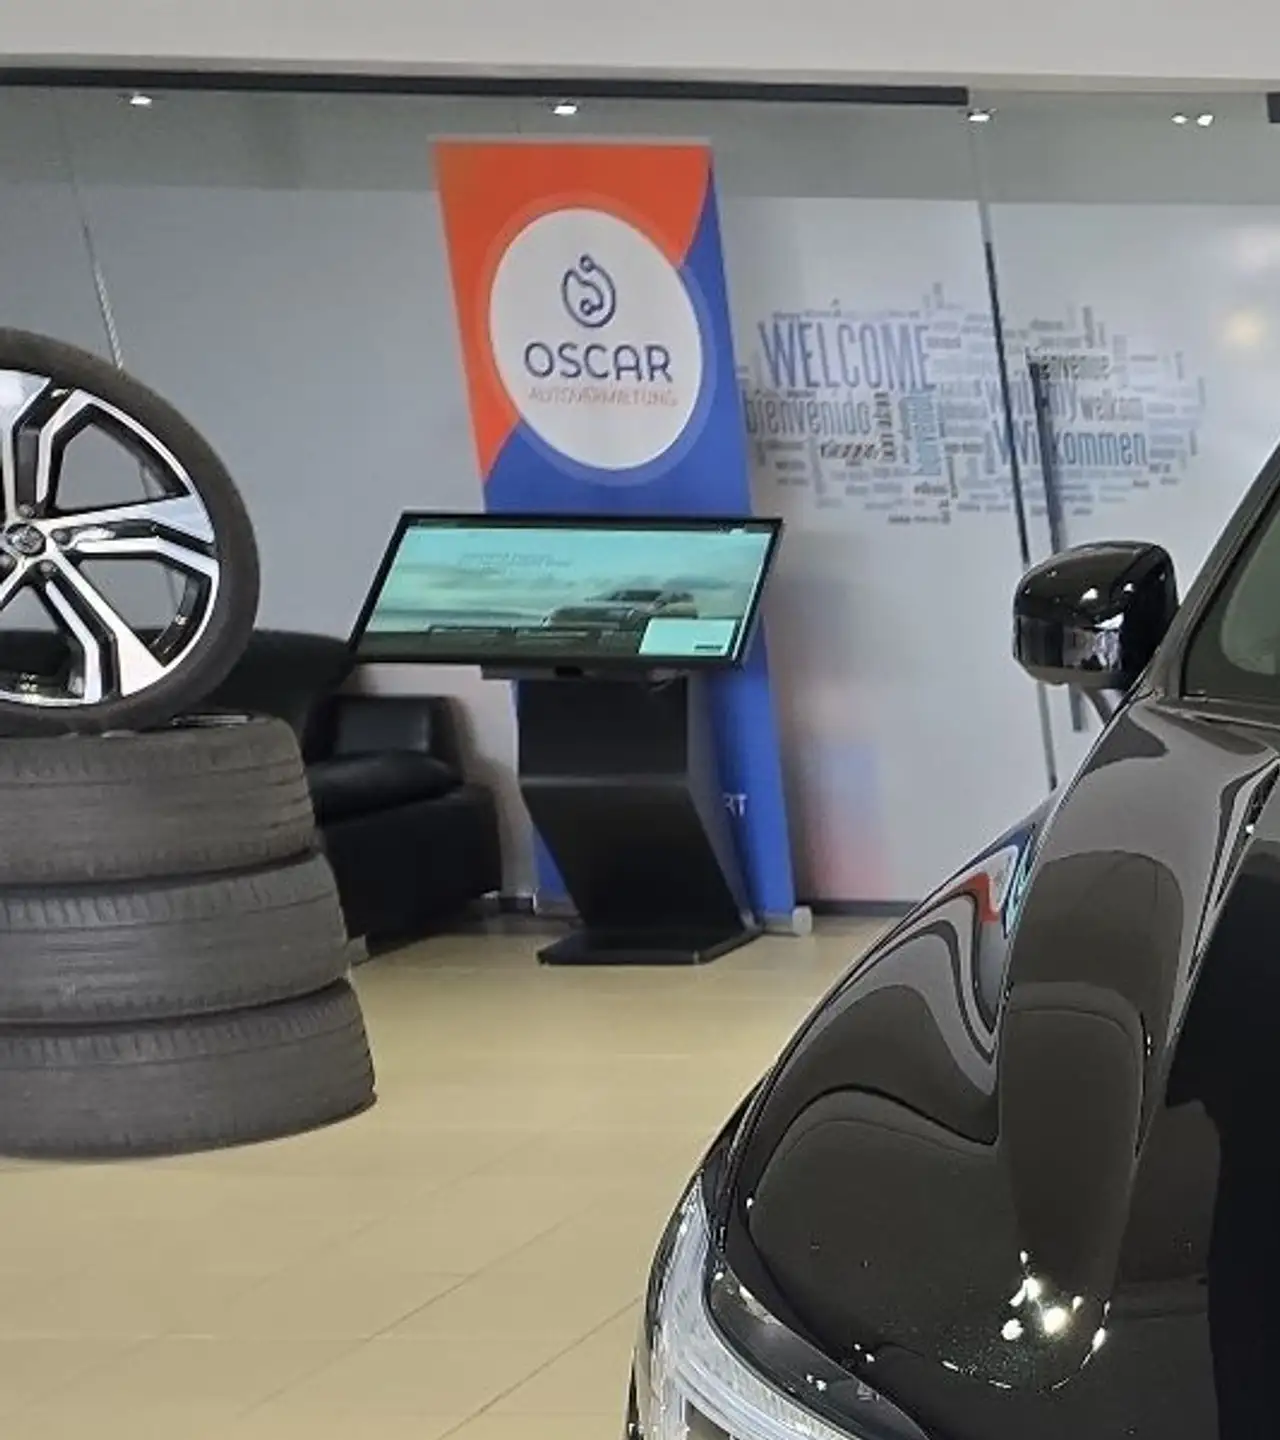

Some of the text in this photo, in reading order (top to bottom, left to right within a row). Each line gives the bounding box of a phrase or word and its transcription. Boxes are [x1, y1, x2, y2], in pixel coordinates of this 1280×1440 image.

[524, 342, 673, 382] OSCAR
[757, 321, 937, 391] WELCOME
[743, 389, 872, 435] bienvenido
